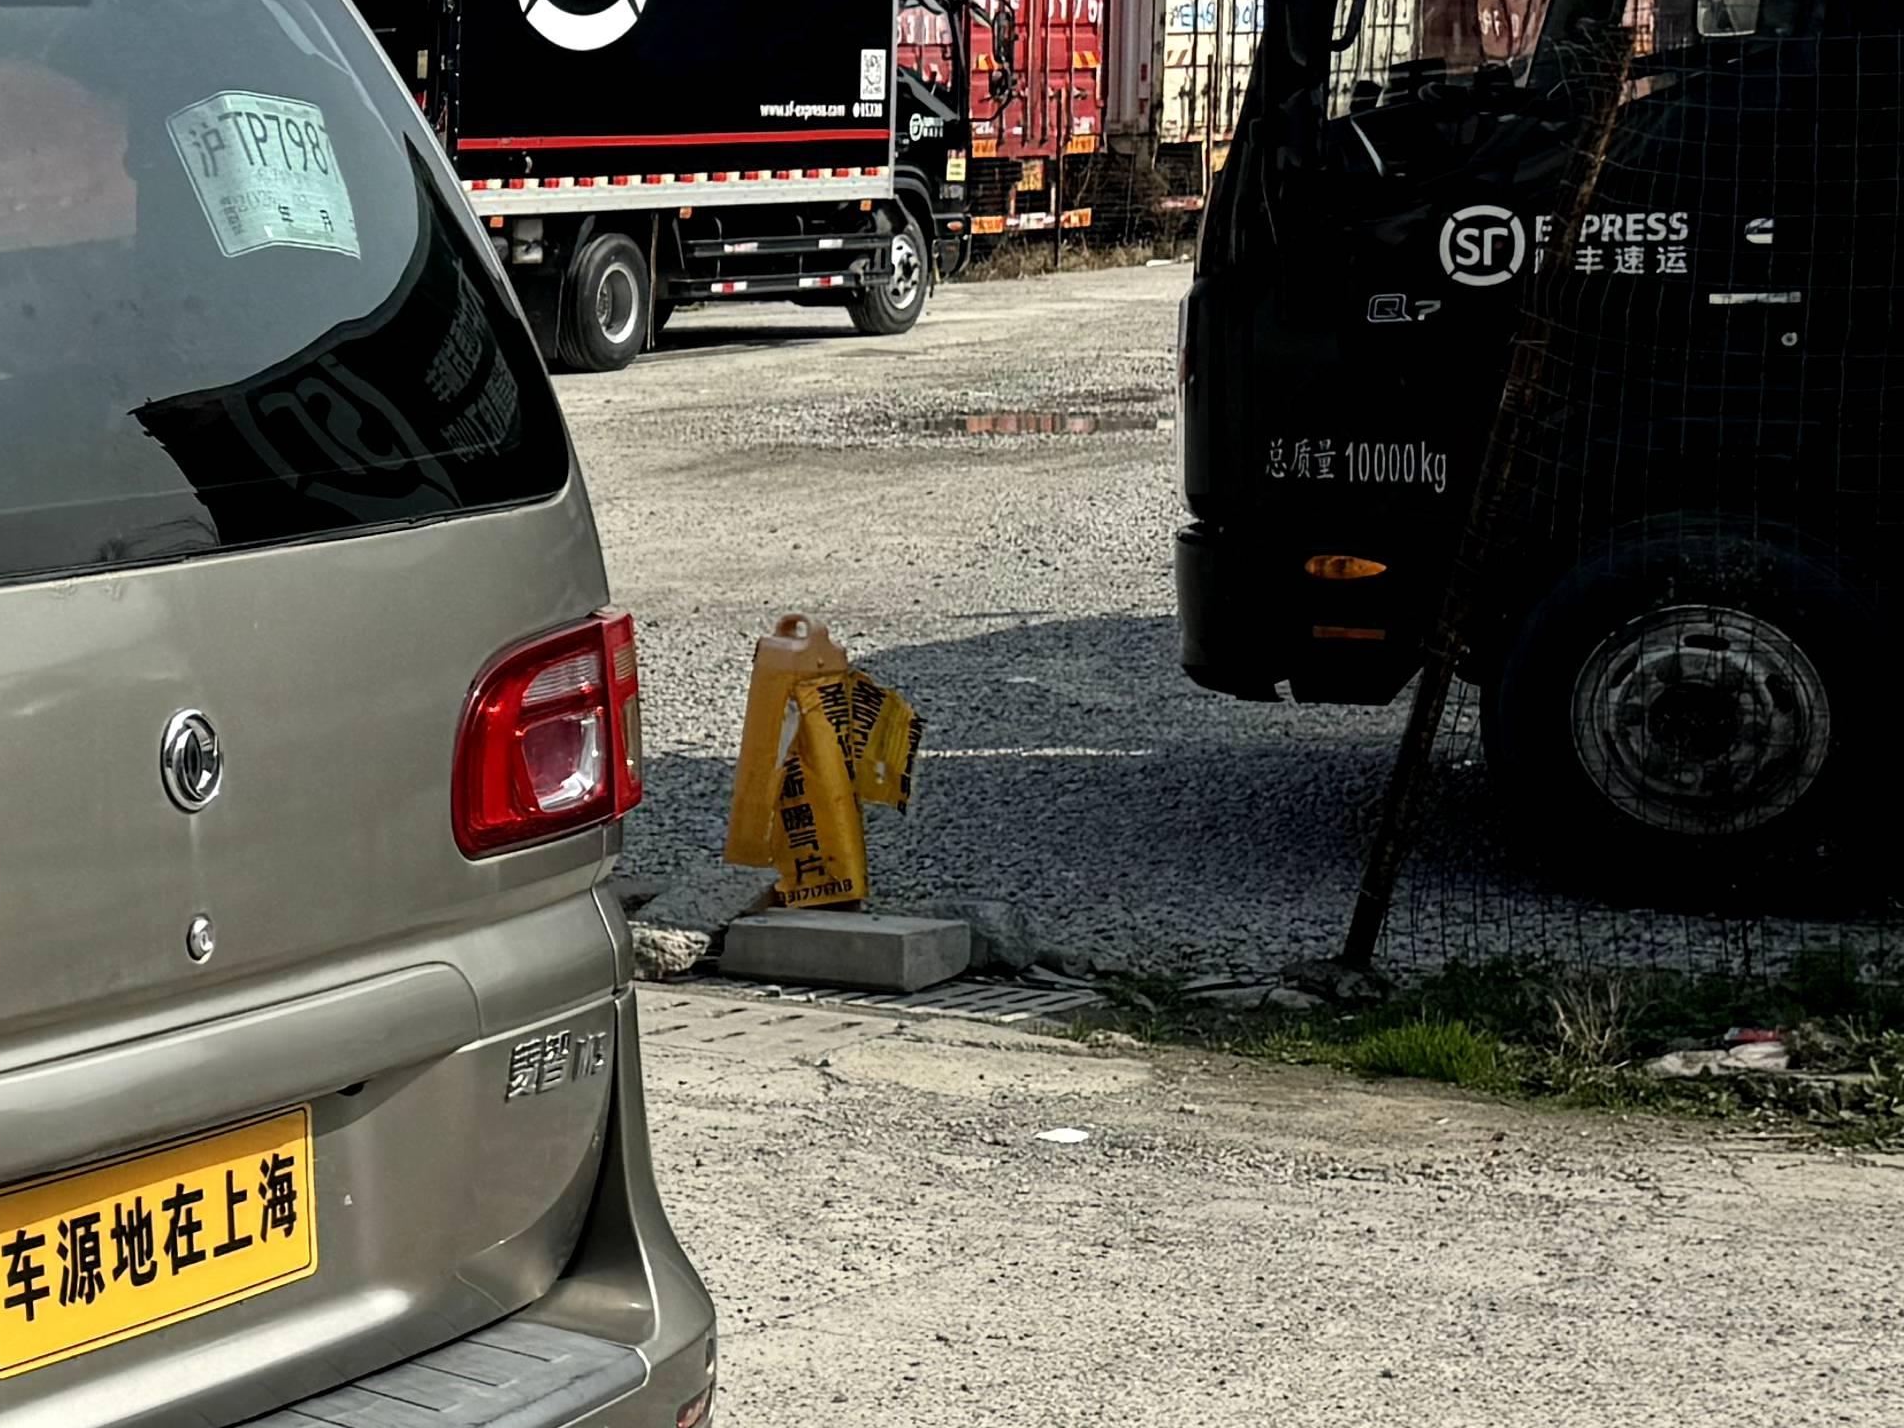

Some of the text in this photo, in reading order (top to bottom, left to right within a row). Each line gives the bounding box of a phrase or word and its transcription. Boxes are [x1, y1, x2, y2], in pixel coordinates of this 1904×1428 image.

[1535, 212, 1689, 243] EPRESS
[1266, 438, 1446, 493] 总质量 10000kg
[1, 1153, 298, 1323] 车源地在上海
